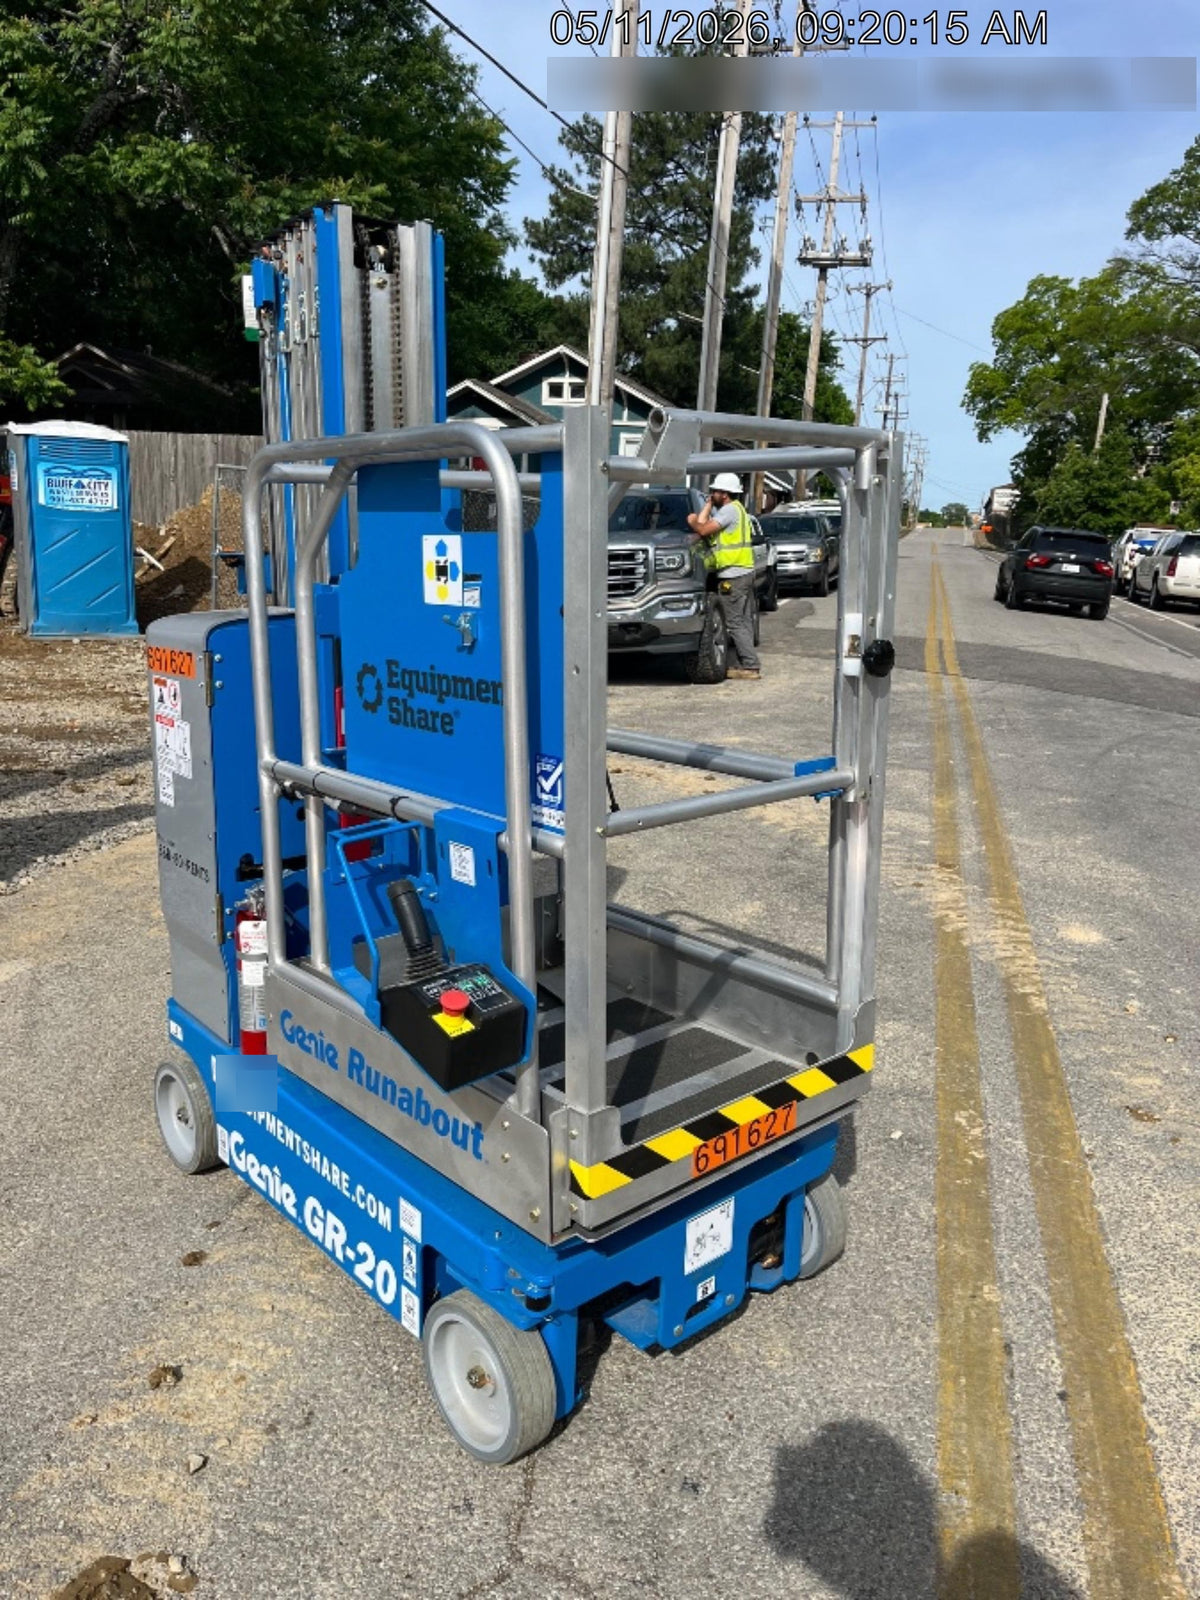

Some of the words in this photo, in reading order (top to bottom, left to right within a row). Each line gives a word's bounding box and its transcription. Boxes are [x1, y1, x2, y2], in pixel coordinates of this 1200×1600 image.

[47, 478, 73, 489] BLUFF
[87, 481, 109, 491] CITY
[147, 646, 193, 677] 691627
[387, 659, 503, 705] Equipmen
[388, 698, 454, 735] Share
[280, 1009, 339, 1072] Genie
[347, 1046, 485, 1162] Runabout
[694, 1103, 794, 1174] 691627
[246, 1111, 392, 1232] PMENTSHARE.COM
[229, 1130, 298, 1219] Genie
[303, 1196, 397, 1305] GR-20
